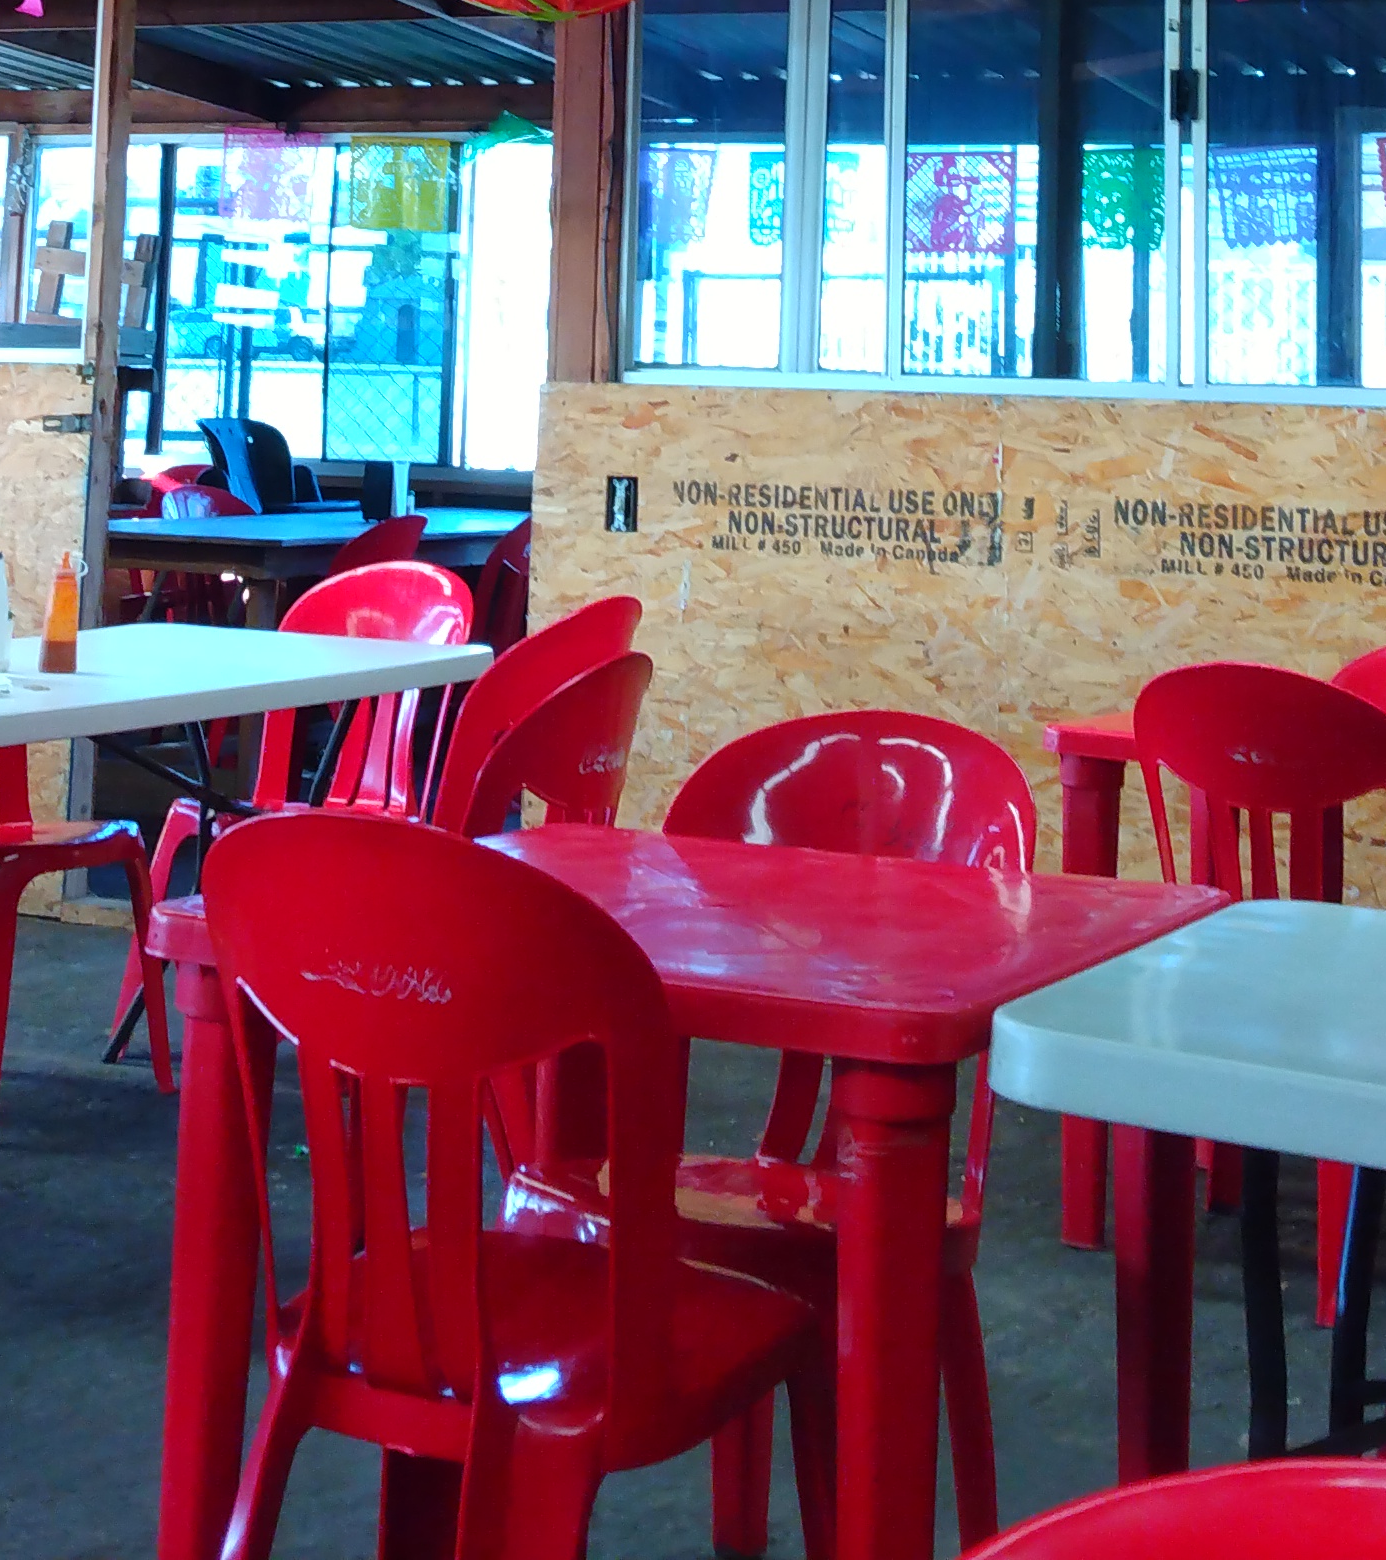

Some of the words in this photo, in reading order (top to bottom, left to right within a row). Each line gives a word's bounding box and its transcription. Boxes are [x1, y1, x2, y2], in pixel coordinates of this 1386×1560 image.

[673, 479, 881, 513] NON-RESIDENTIAL
[889, 488, 935, 515] USE
[728, 509, 941, 543] NON-STRUCTURAL
[1114, 498, 1355, 536] NON-RESIDENTIAL
[771, 539, 802, 555] 450
[819, 540, 864, 558] Made
[1160, 557, 1208, 576] MILL
[1285, 567, 1337, 584] Made
